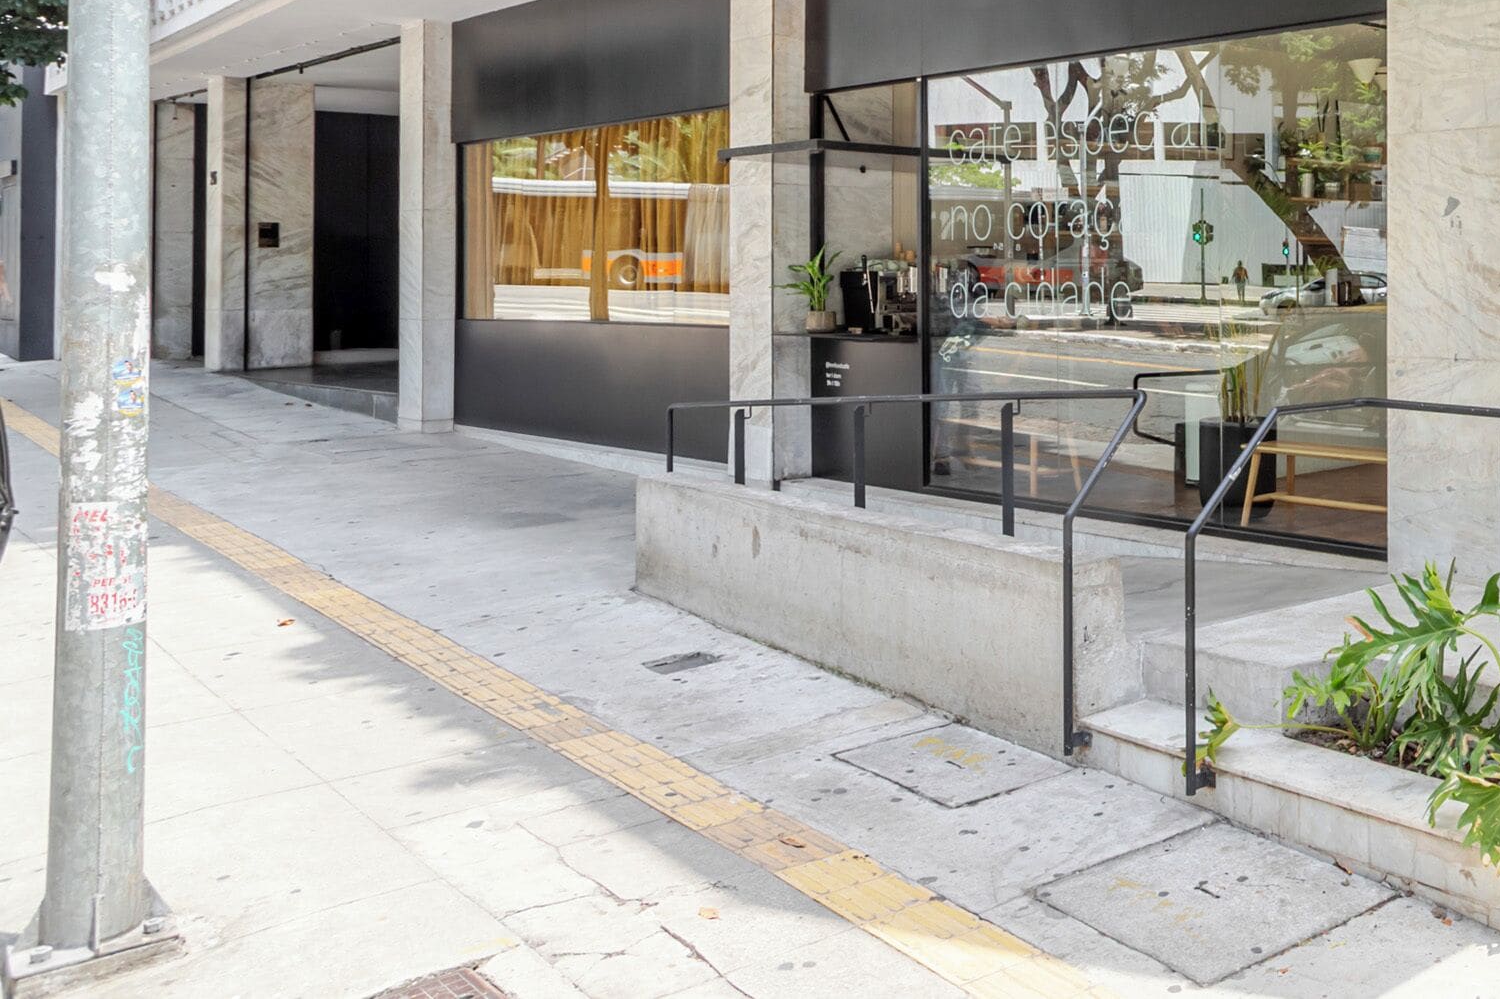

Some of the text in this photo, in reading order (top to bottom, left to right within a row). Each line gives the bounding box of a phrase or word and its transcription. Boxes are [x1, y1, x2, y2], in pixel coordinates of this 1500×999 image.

[951, 203, 993, 241] no
[950, 266, 1132, 322] da cidade
